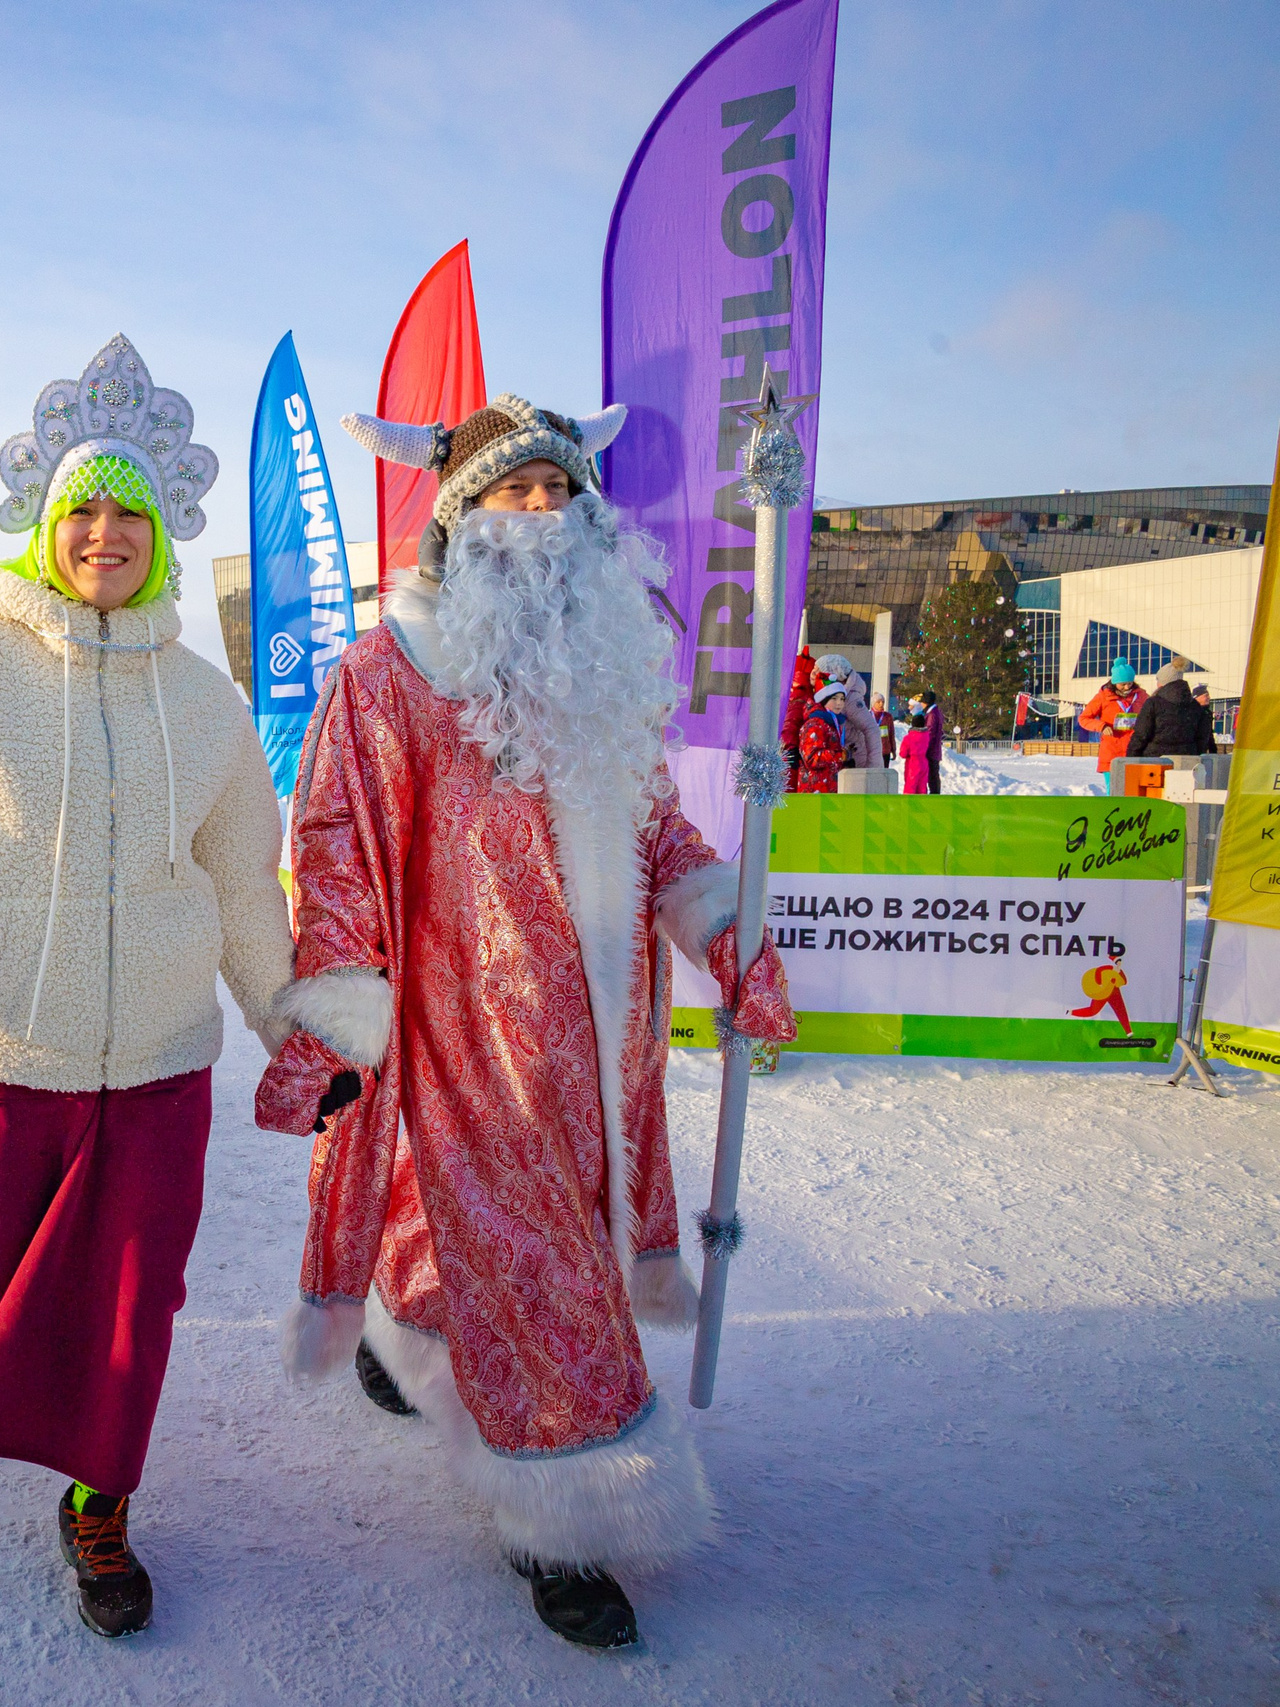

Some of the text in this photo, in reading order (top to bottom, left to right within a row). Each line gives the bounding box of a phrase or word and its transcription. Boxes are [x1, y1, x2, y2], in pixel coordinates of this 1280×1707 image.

[1102, 807, 1152, 843] бегу
[1058, 828, 1180, 881] и обещаю
[768, 895, 1086, 927] ЕЩАЮ В 2024 ГОДУ
[824, 929, 1010, 955] ЛОЖИТЬСЯ
[1020, 933, 1126, 957] СПАТЬ
